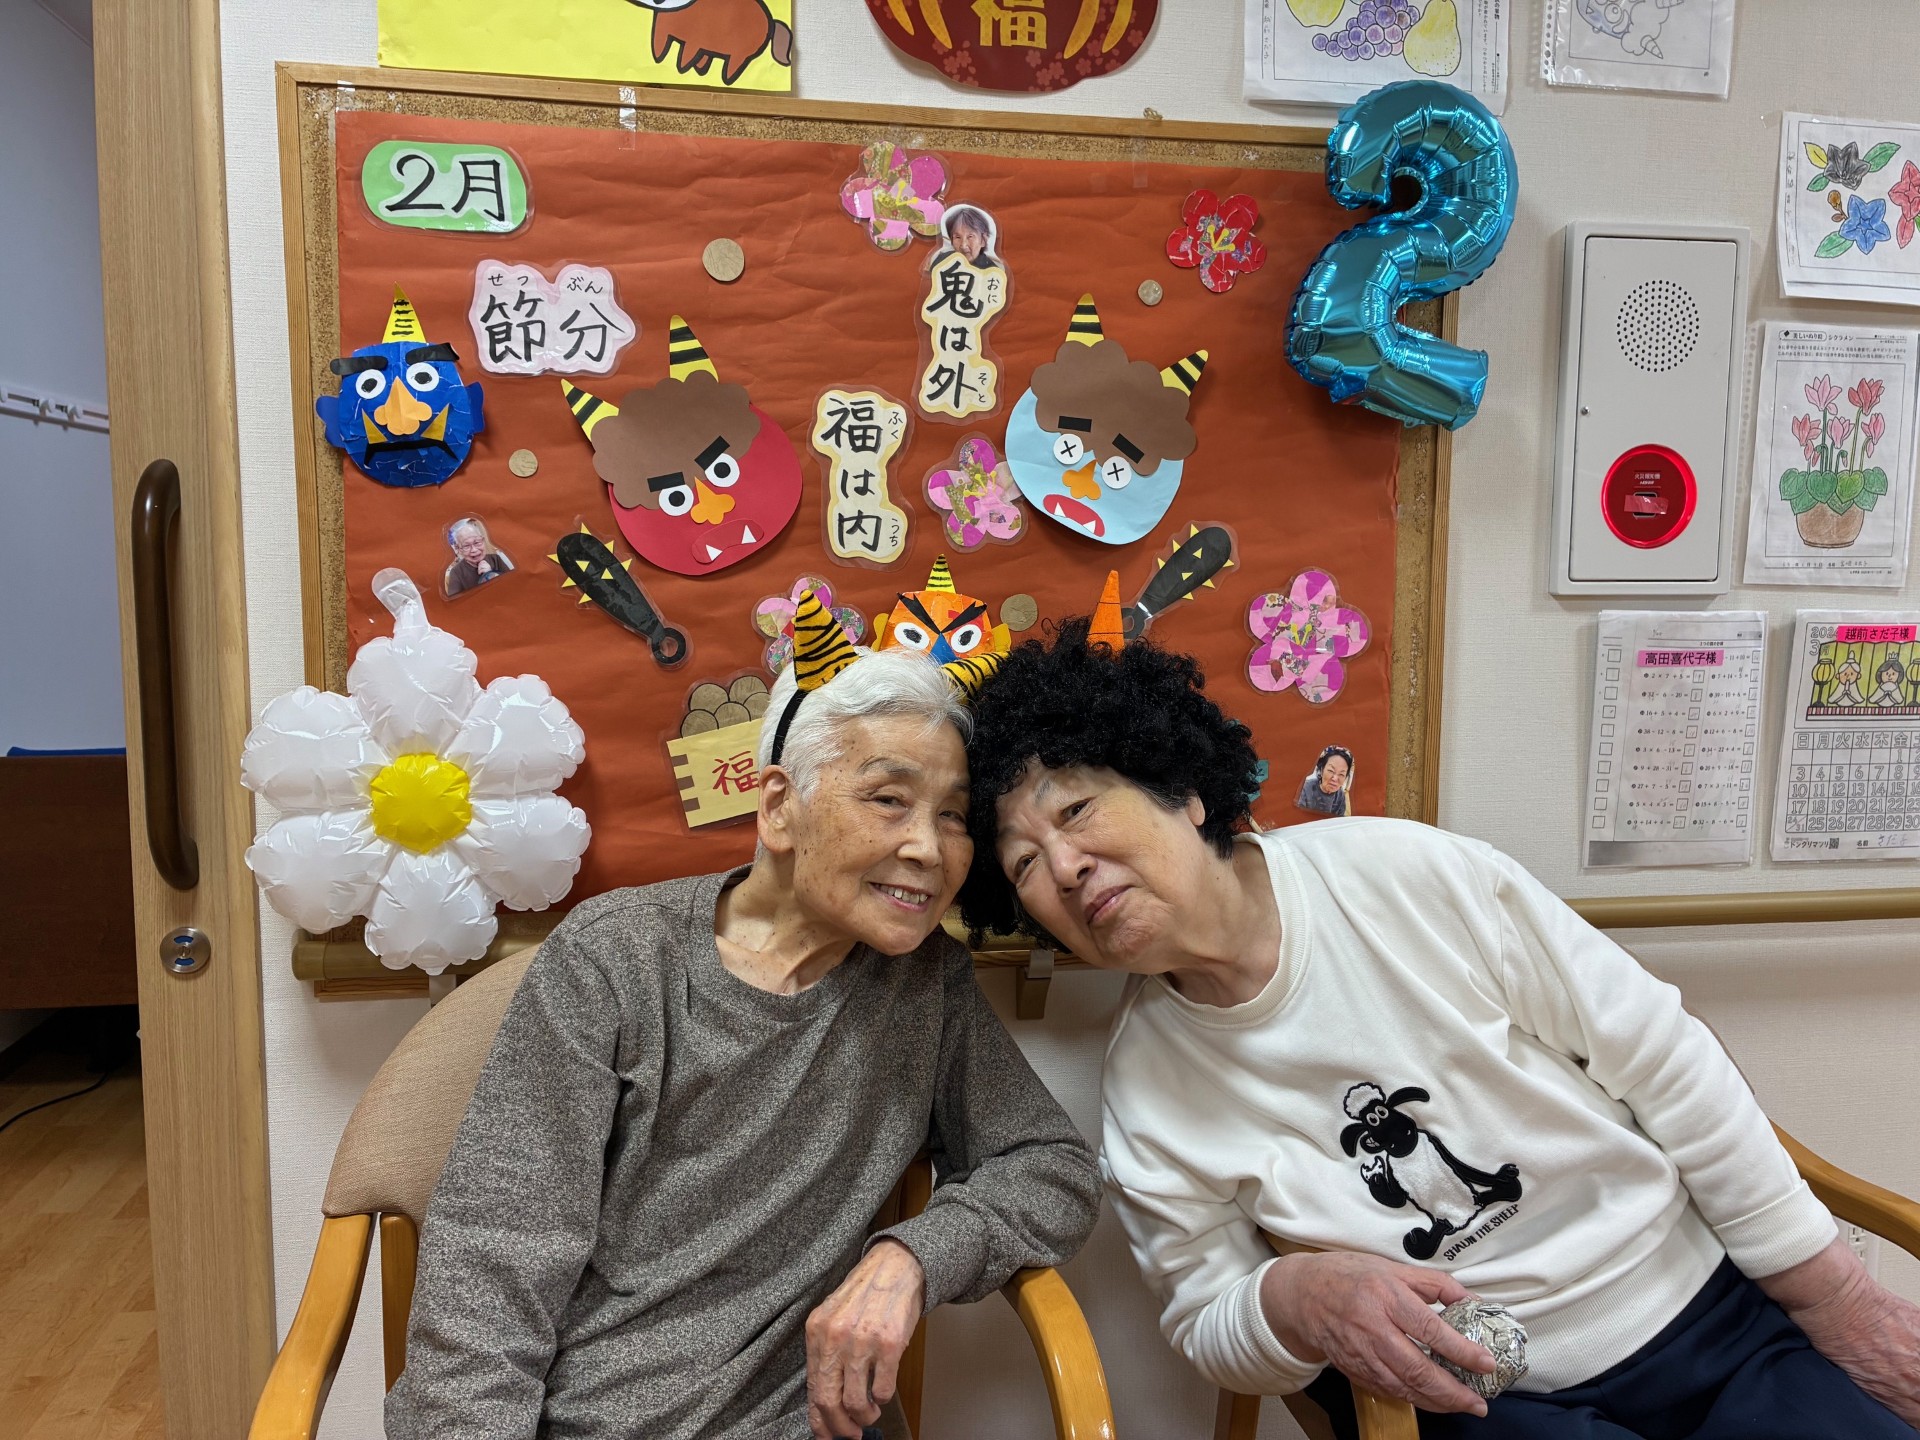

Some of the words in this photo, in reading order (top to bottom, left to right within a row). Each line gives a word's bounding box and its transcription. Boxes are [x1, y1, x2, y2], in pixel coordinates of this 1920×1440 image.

[385, 154, 505, 222] 2月
[488, 274, 529, 287] せつ
[567, 277, 604, 294] ぶん
[986, 277, 1000, 304] おに
[480, 289, 626, 363] 節分
[926, 260, 984, 410] 鬼は外
[976, 372, 988, 404] そと
[888, 411, 904, 440] ふく
[821, 397, 882, 552] 福は内
[889, 517, 898, 547] うち
[1844, 627, 1910, 640] 越前さだ子様
[1645, 652, 1716, 666] 高田喜代子様
[1797, 733, 1809, 748] 日
[1817, 732, 1829, 748] 月
[1835, 732, 1851, 748] 火
[1855, 732, 1870, 748] 水
[1874, 732, 1889, 748] 木
[1894, 732, 1908, 748] 金
[712, 751, 759, 796] 福
[1796, 767, 1805, 780] 3
[1816, 767, 1825, 780] 4
[1835, 766, 1844, 780] 5
[1855, 766, 1863, 780] 6
[1874, 765, 1884, 780] 7
[1894, 765, 1903, 779] 8
[1792, 784, 1808, 797] 10
[1813, 784, 1825, 797] 11
[1832, 783, 1845, 796] 12
[1852, 783, 1865, 796] 13
[1871, 782, 1885, 796] 14
[1890, 782, 1905, 796] 15
[1791, 801, 1806, 814] 17
[1812, 800, 1825, 814] 18
[1831, 799, 1844, 814] 19
[1848, 799, 1865, 813] 20
[1869, 798, 1883, 813] 21
[1887, 798, 1904, 813] 22
[1808, 817, 1825, 830] 25
[1828, 816, 1844, 830] 26
[1847, 816, 1864, 830] 27
[1867, 815, 1884, 830] 28
[1886, 815, 1902, 829] 29
[1444, 1236, 1478, 1262] SHAUN
[1476, 1222, 1494, 1239] THE
[1490, 1204, 1519, 1227] SHEEP
